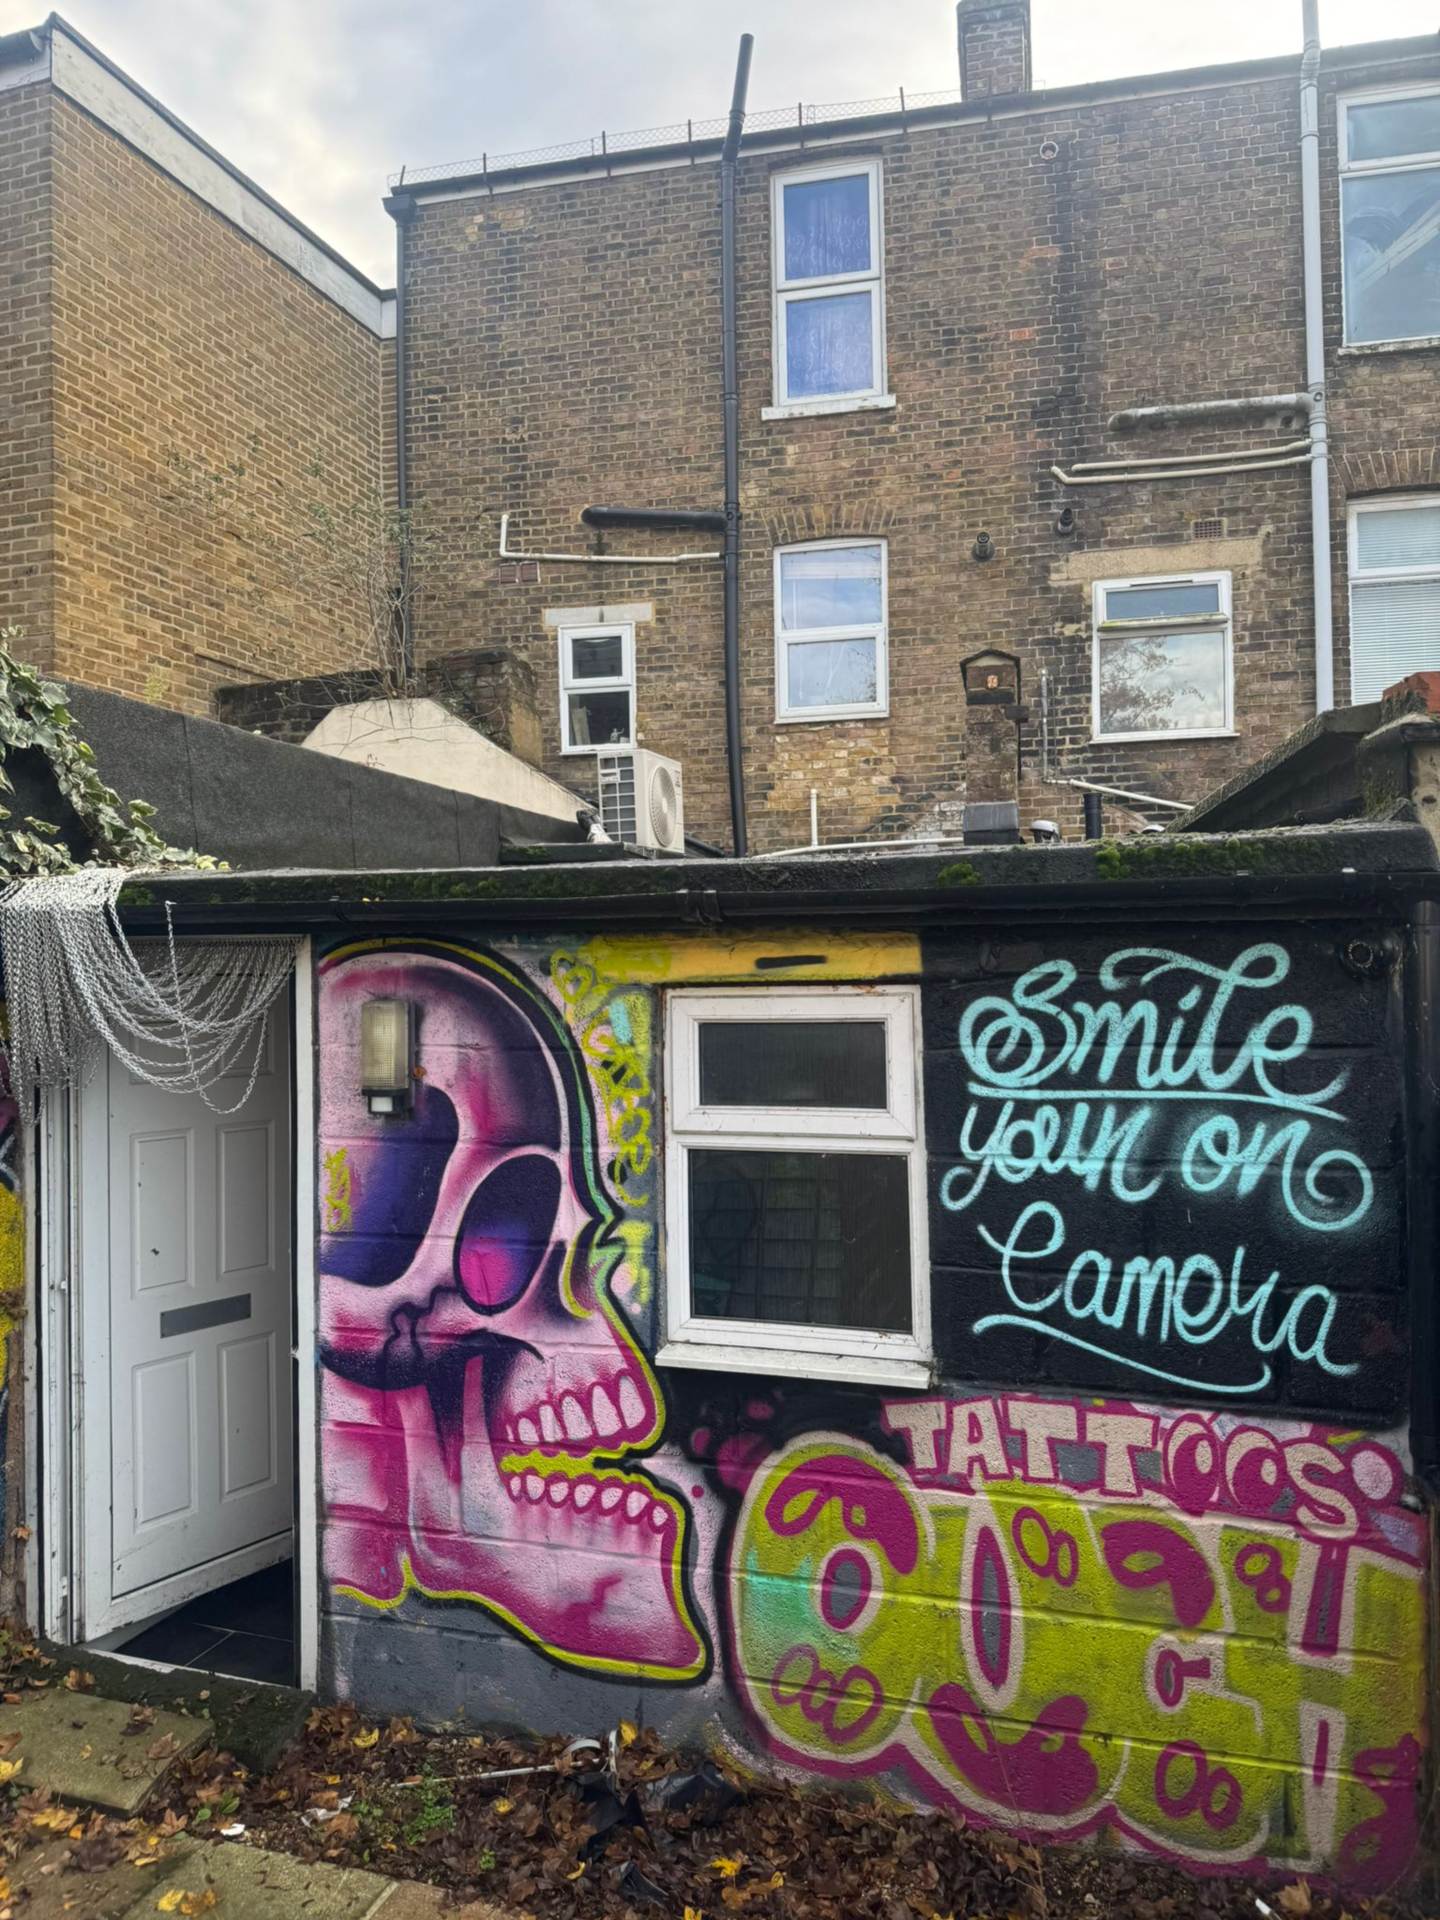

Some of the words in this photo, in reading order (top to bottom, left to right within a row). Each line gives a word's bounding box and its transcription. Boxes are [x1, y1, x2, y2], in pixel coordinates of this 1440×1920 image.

[959, 943, 1350, 1106] Smile
[1181, 1114, 1374, 1231] on
[977, 1201, 1361, 1376] Camera
[883, 1397, 1362, 1540] TATTOOS
